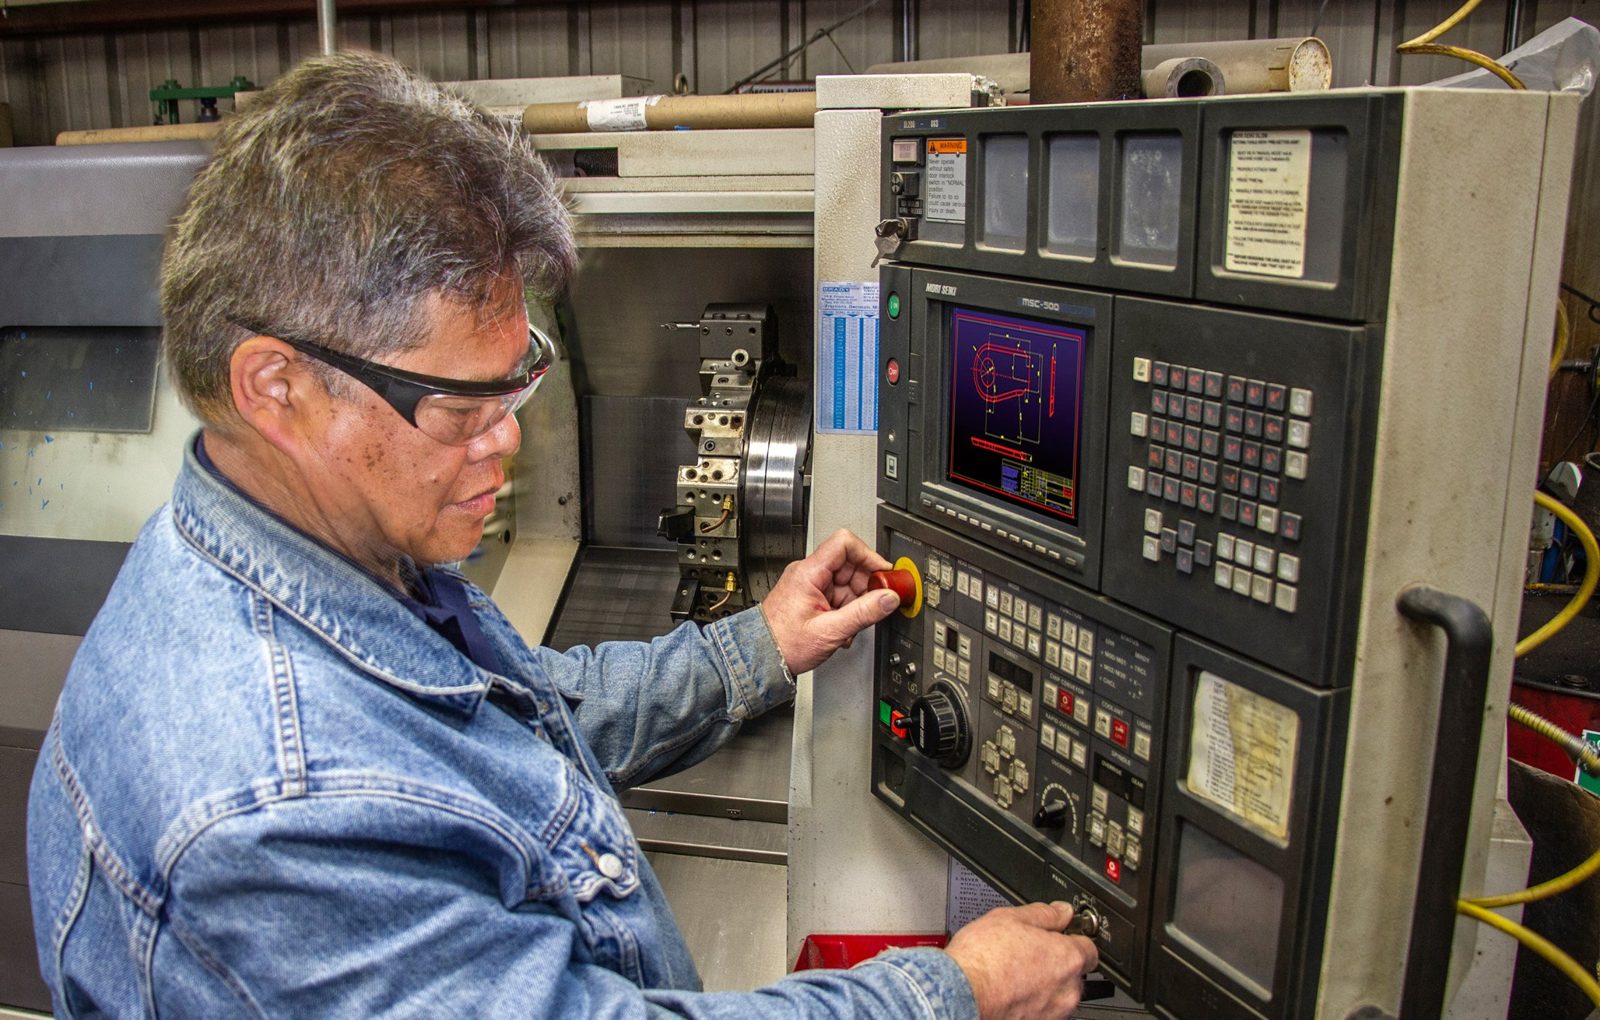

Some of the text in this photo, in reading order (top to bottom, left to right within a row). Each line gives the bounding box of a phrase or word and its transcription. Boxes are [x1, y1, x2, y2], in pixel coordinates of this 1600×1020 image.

[926, 283, 957, 296] MORI SEIKI
[1052, 874, 1067, 888] PANEL
